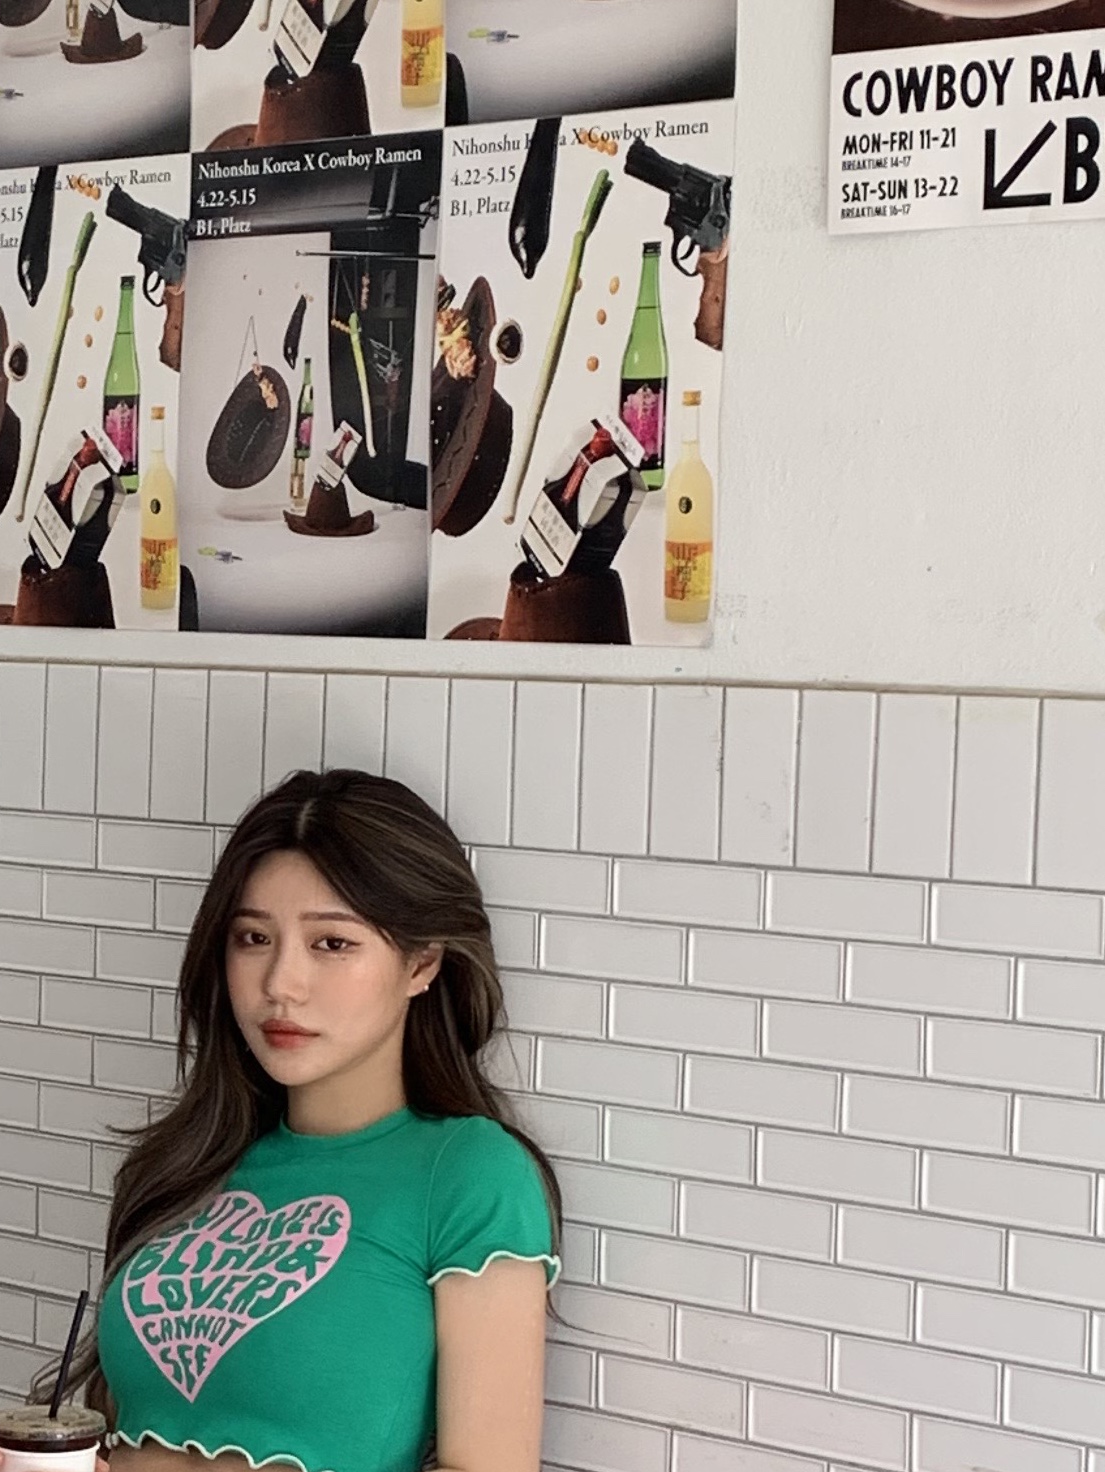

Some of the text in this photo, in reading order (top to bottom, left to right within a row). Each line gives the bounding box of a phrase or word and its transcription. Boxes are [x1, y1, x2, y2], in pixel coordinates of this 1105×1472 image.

[842, 57, 1015, 118] COWBOY
[451, 134, 521, 157] Nihonshu
[571, 127, 584, 146] X
[654, 119, 709, 139] Ramen
[842, 126, 956, 156] MON-FRI 11-21
[198, 146, 423, 180] Nihonshu Korea X Cowboy Ramen
[451, 165, 517, 187] 4.22-5.15
[841, 156, 888, 172] BREAKTIME
[1063, 116, 1101, 204] B
[65, 174, 76, 191] X
[129, 168, 172, 185] Ramen
[841, 175, 959, 203] SAT-SUN 13-22
[196, 188, 257, 208] 4.22-5.15
[476, 196, 511, 216] Platz
[840, 205, 888, 220] BREAKTIME
[220, 216, 251, 234] Platz
[216, 1201, 323, 1245] LOVE
[308, 1203, 344, 1236] IS
[127, 1232, 331, 1282] BLIND &
[127, 1272, 302, 1319] LOVERS
[142, 1313, 247, 1347] CANNOT
[159, 1343, 211, 1394] SEE
